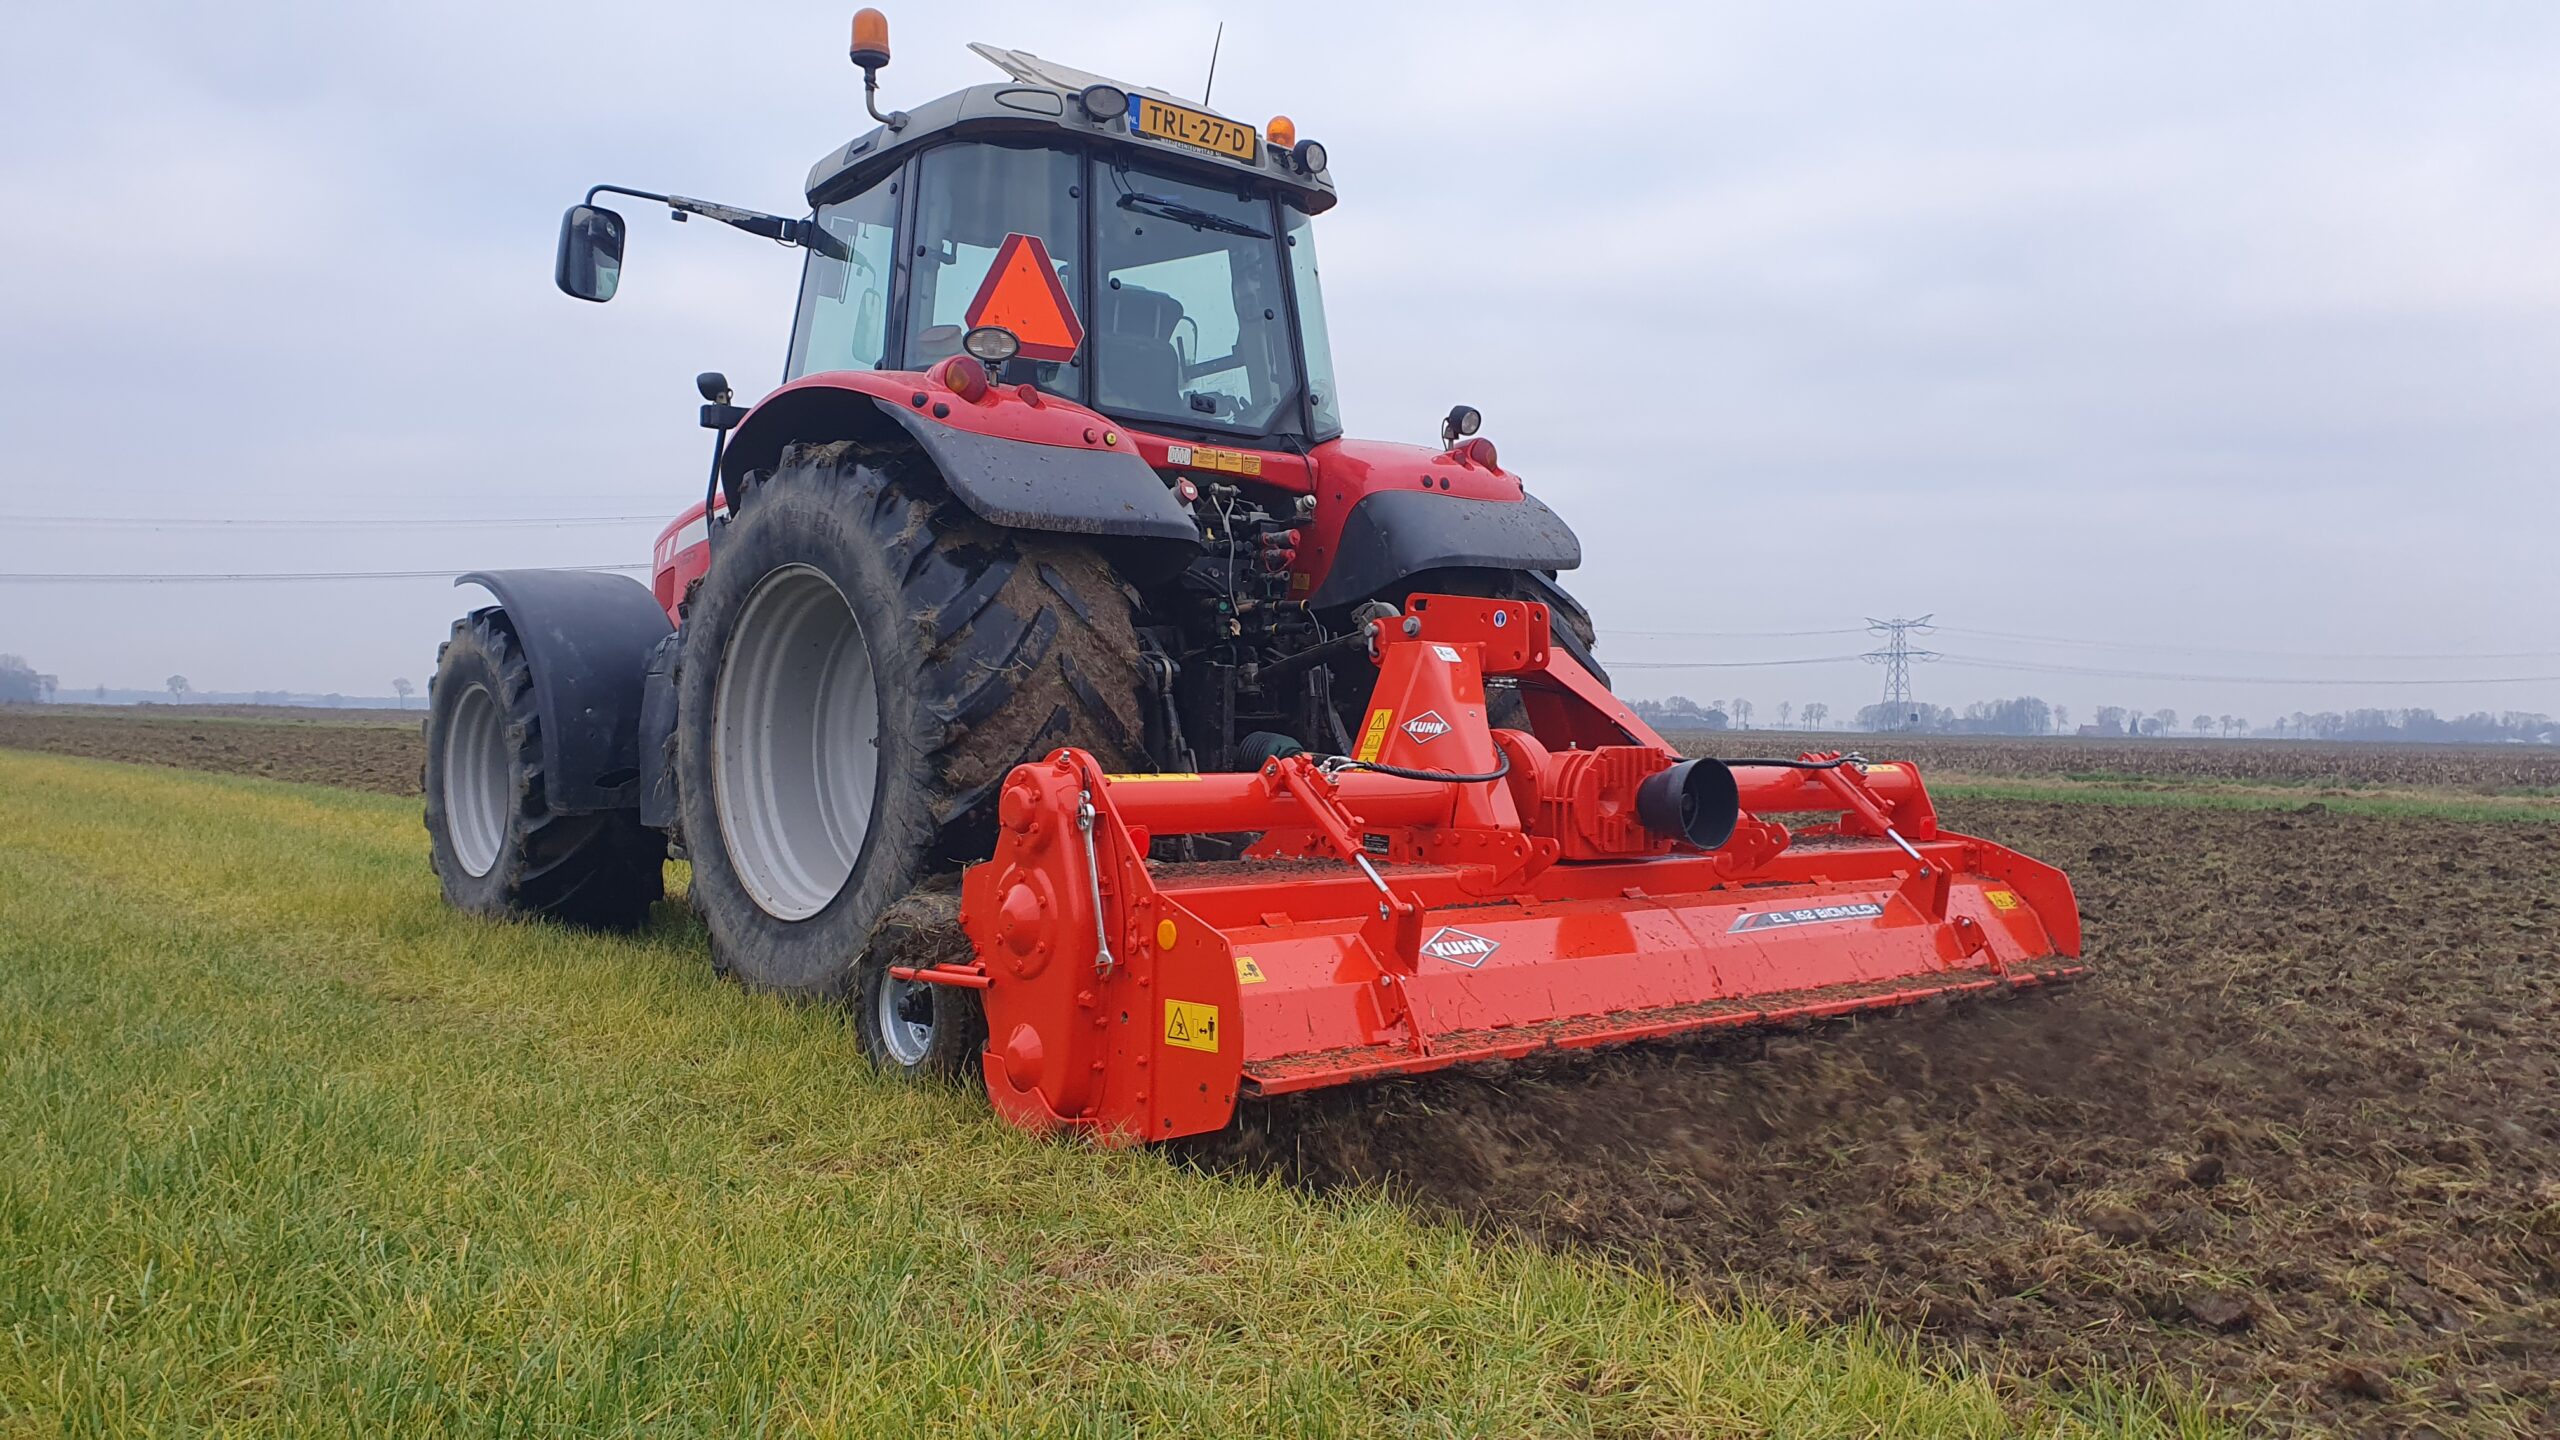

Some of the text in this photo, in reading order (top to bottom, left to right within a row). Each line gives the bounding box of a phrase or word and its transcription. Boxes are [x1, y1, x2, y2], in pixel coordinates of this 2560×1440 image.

[1128, 114, 1138, 125] NL
[1149, 105, 1245, 152] TRL-27-D
[1409, 721, 1444, 734] KUHN
[1769, 904, 1881, 923] EL 162 BIOMULCH
[1431, 939, 1490, 956] KUHN
